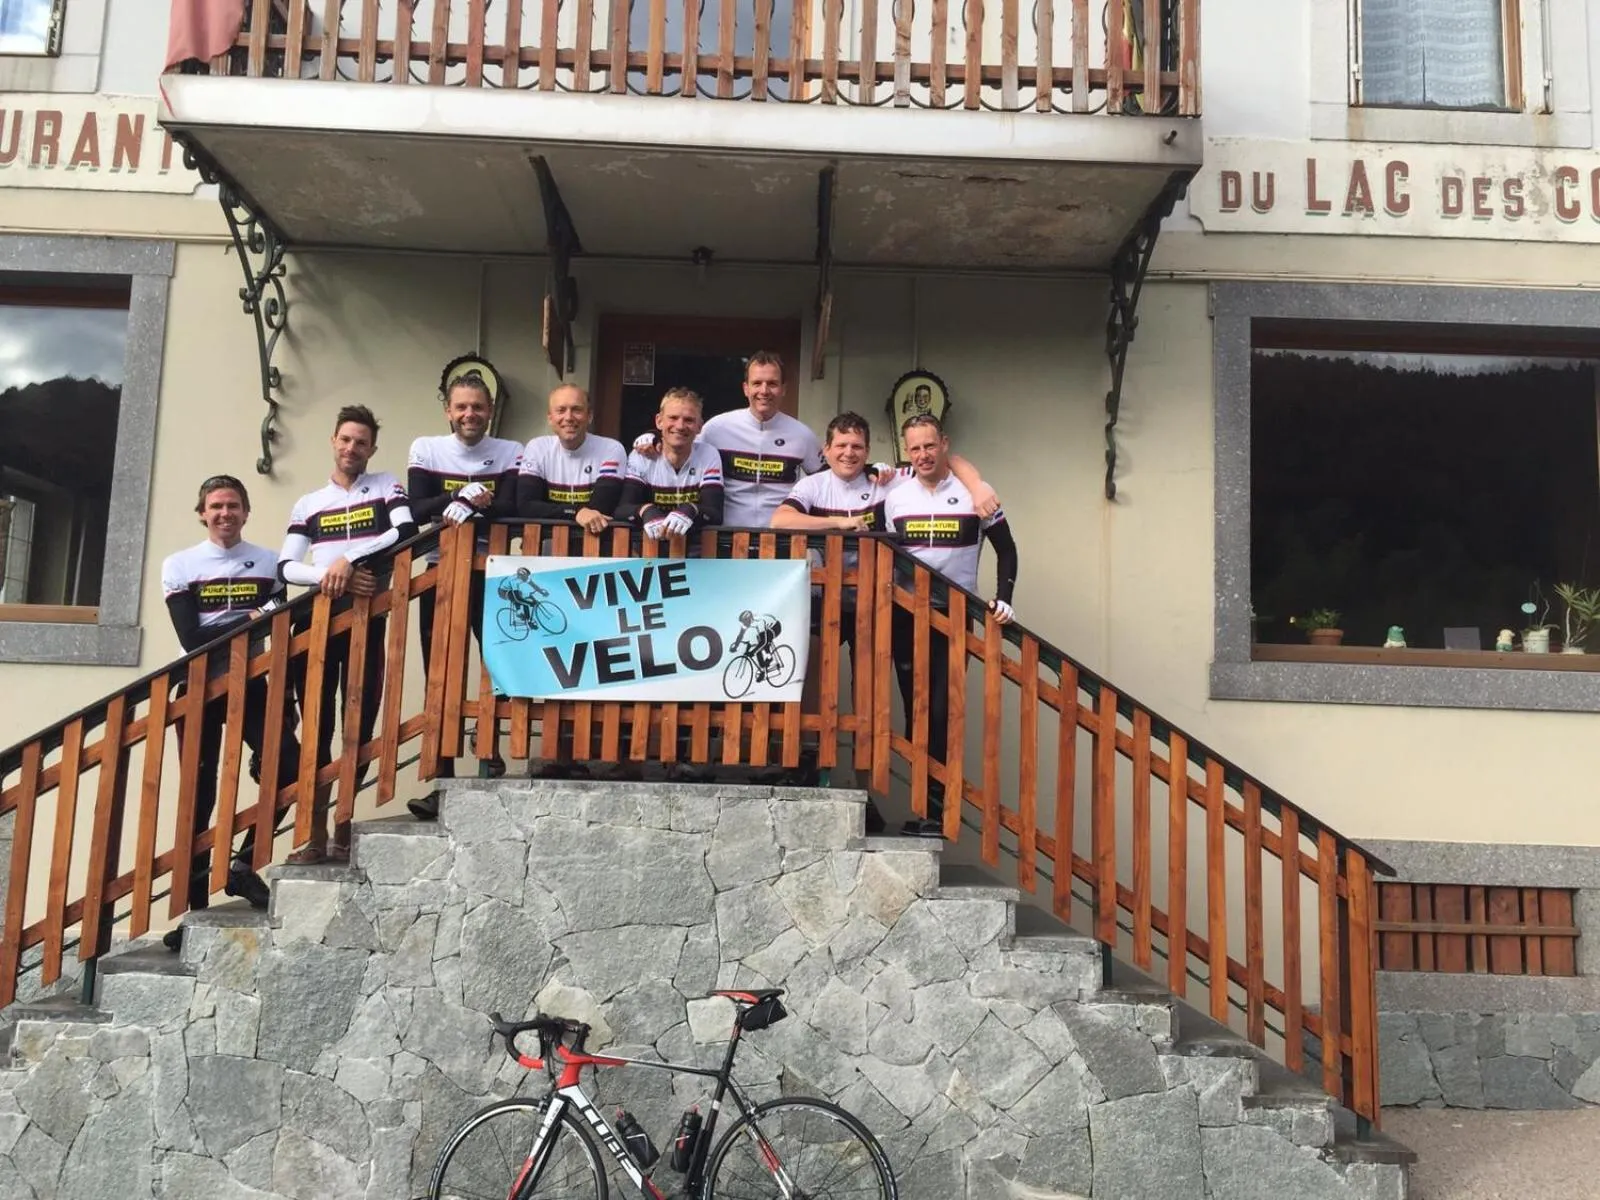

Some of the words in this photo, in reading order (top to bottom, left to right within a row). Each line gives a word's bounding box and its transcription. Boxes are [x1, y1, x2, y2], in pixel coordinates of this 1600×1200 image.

[1220, 169, 1275, 213] DU
[1306, 158, 1411, 216] LAC
[1441, 176, 1526, 219] DES
[565, 562, 690, 610] VIVE
[618, 602, 666, 634] LE
[543, 625, 723, 689] VELO
[580, 1104, 635, 1171] CUBE
